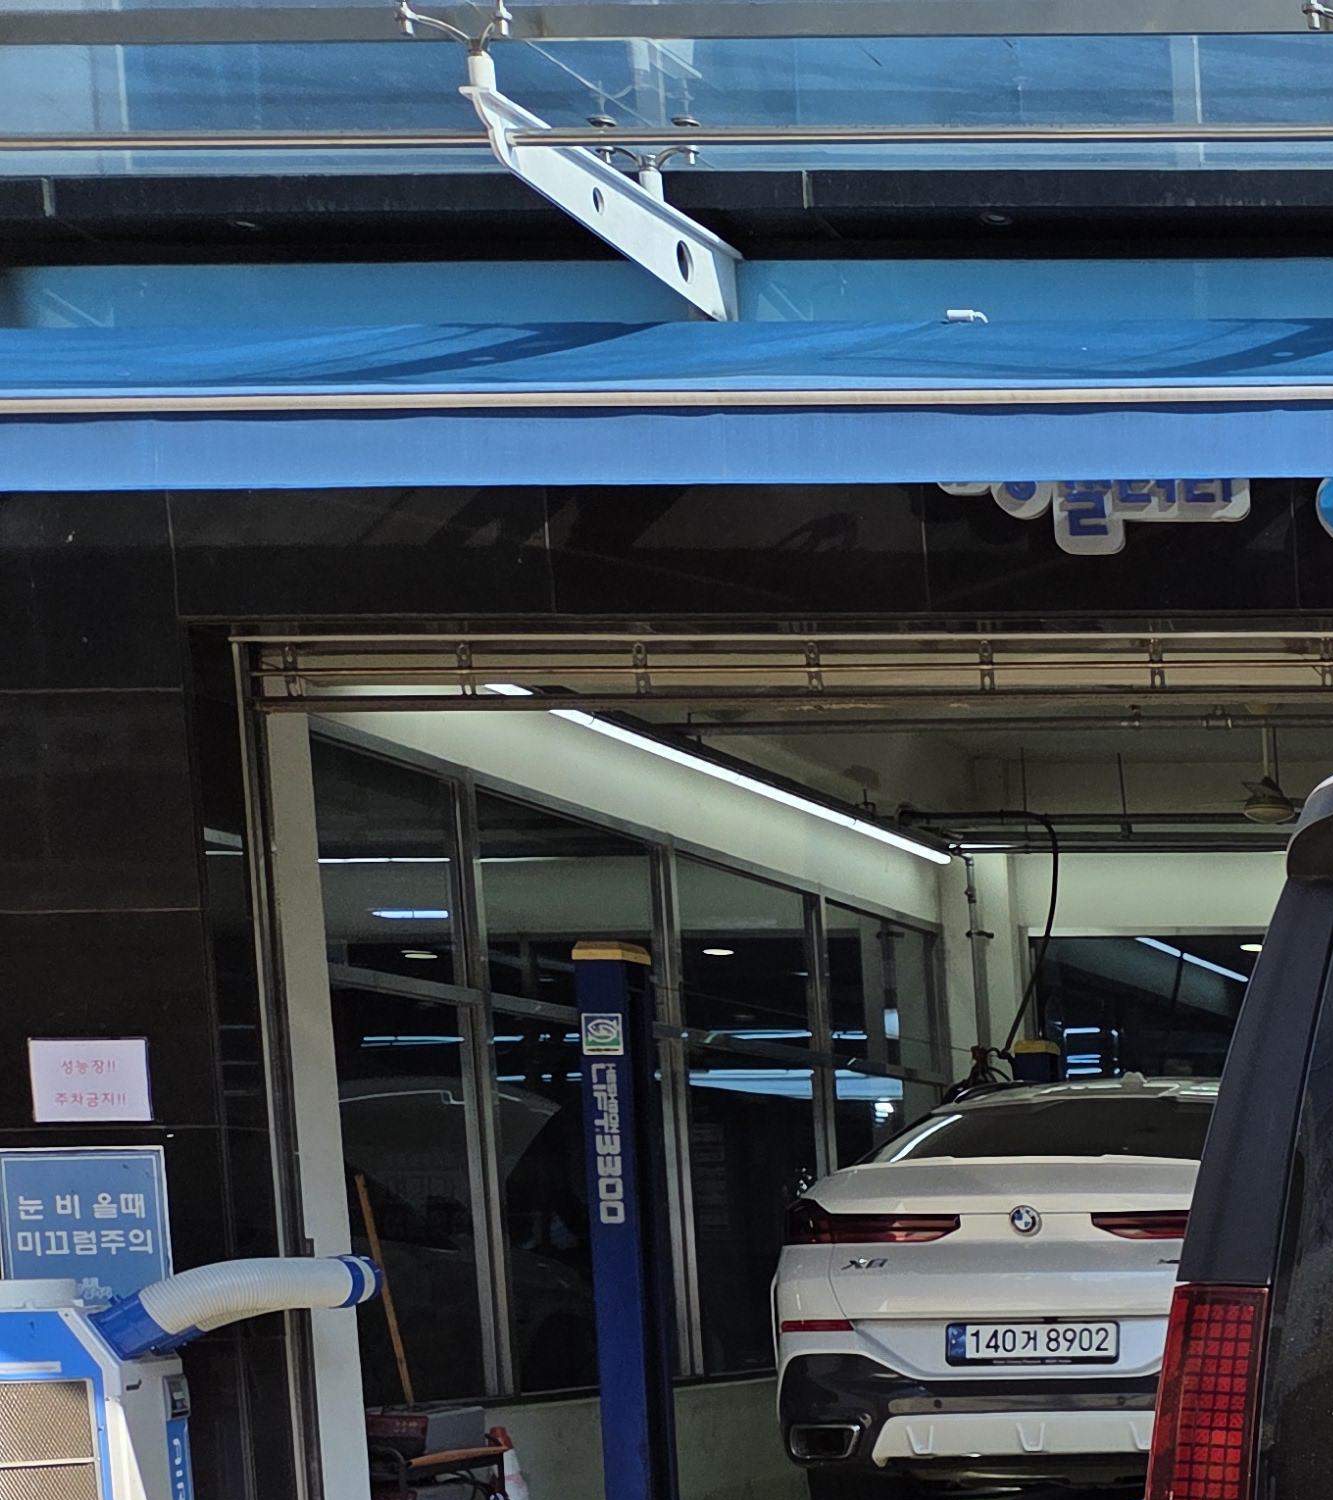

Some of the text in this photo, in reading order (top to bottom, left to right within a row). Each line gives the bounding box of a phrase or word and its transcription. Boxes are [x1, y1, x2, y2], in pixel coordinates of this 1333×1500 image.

[18, 1195, 44, 1220] 눈
[55, 1194, 81, 1220] 비
[17, 1228, 154, 1257] 미끄럼주의
[970, 1327, 1110, 1354] 140거 8902
